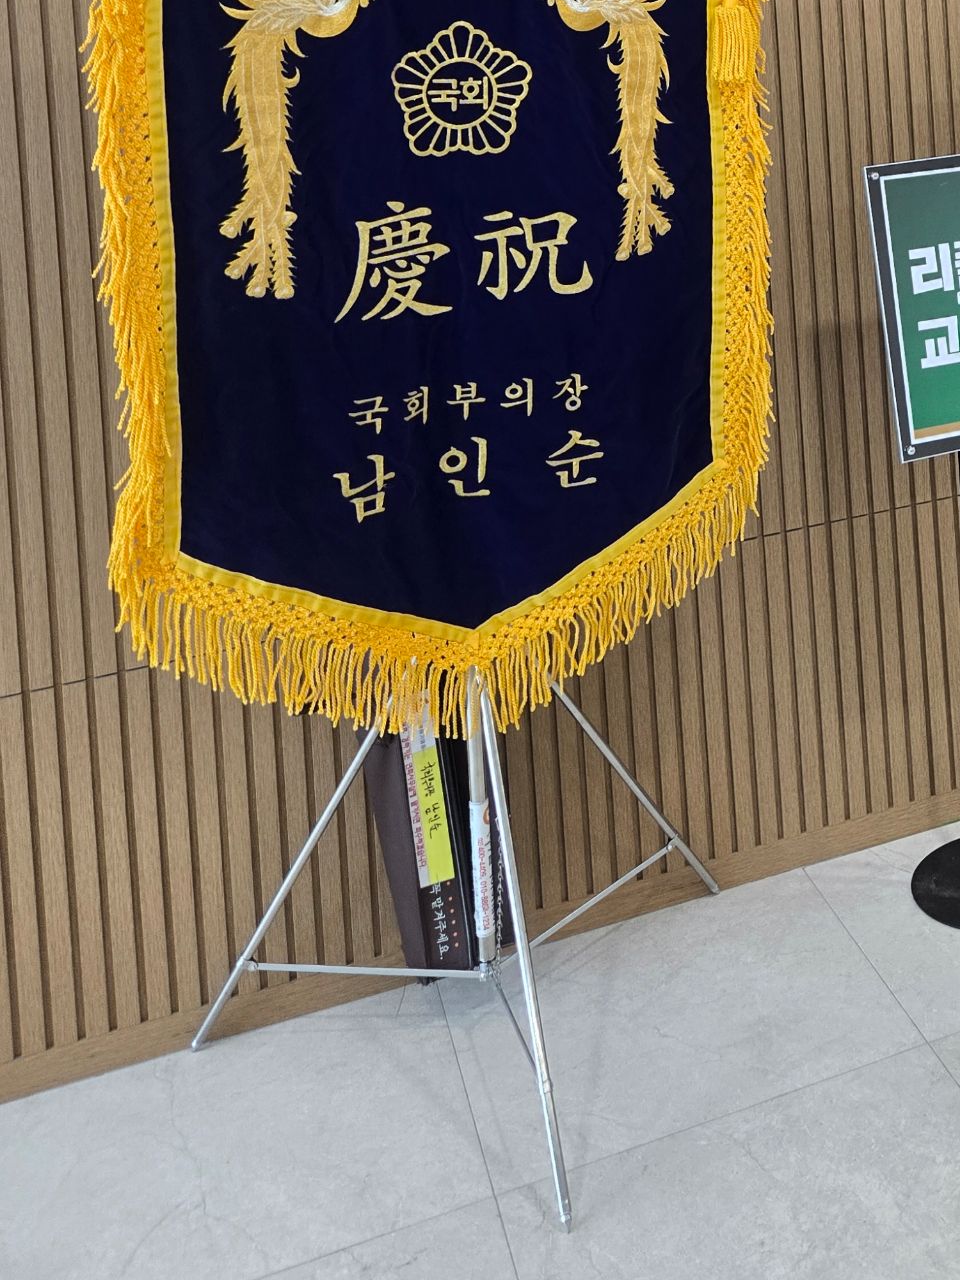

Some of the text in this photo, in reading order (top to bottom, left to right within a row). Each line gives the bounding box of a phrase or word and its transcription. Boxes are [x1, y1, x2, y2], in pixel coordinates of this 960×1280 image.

[427, 76, 490, 113] 국회
[334, 201, 594, 323] 慶祝
[425, 802, 442, 839] 남인순
[431, 897, 450, 960] 맡겨주세요.
